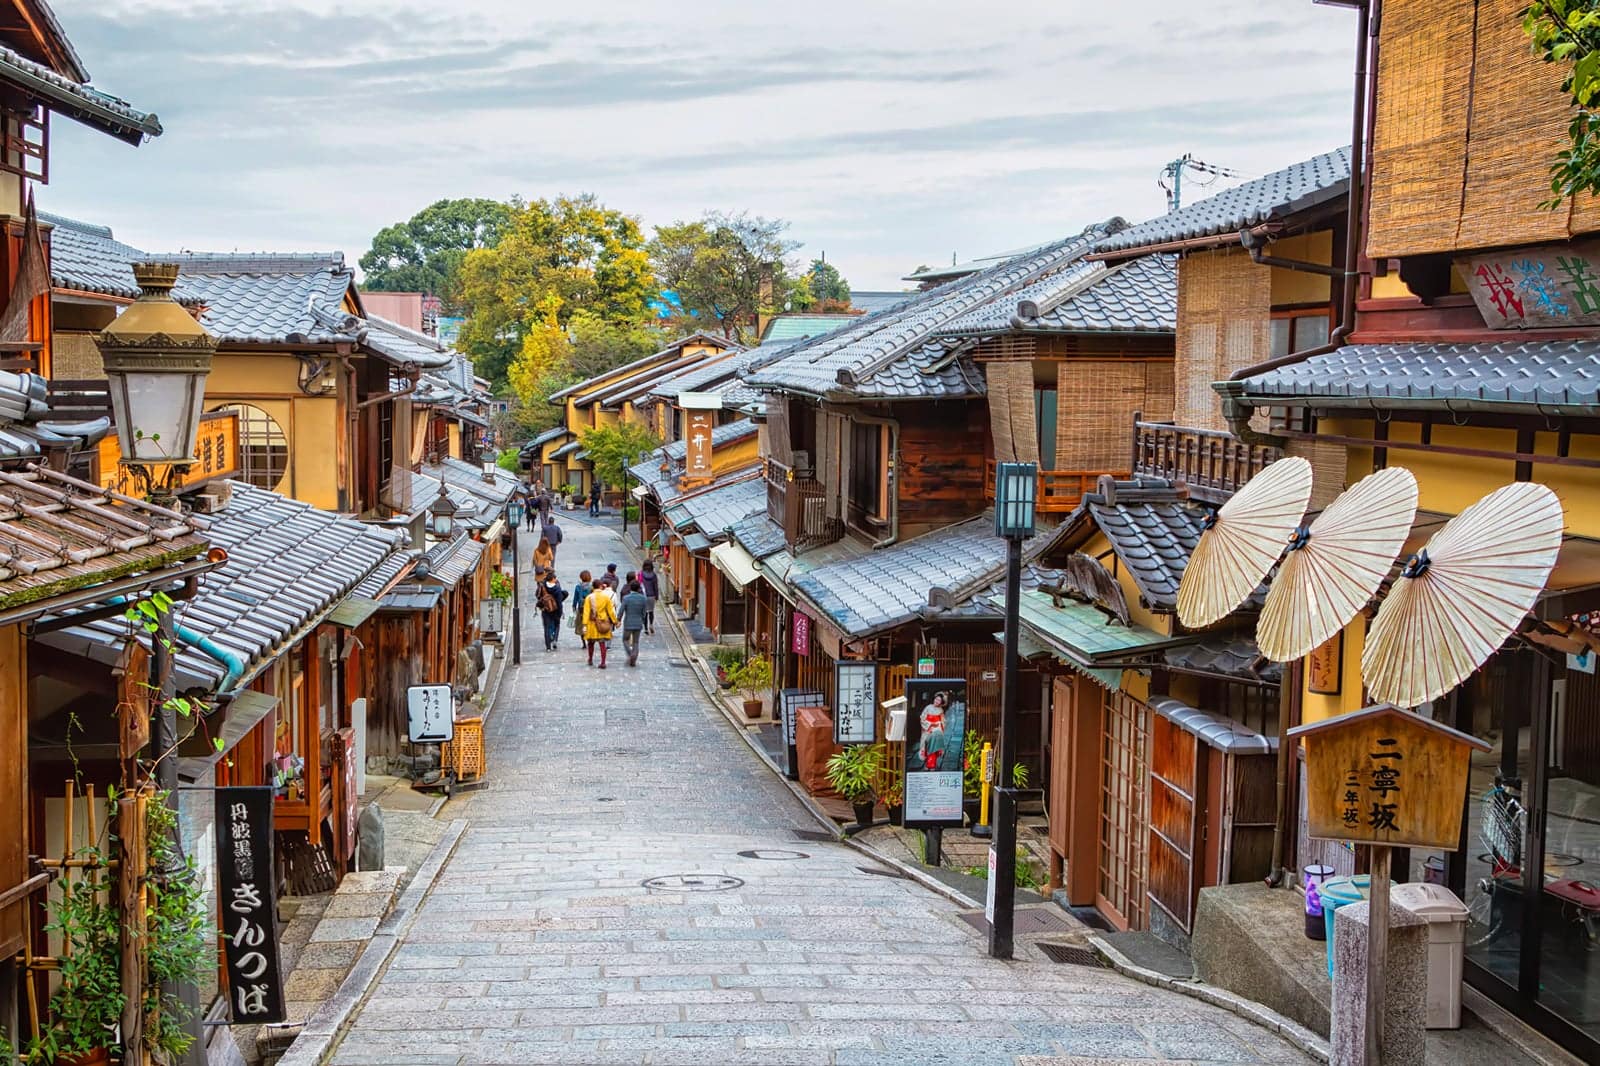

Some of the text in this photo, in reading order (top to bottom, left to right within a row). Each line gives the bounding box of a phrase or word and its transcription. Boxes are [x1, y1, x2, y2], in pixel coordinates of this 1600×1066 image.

[840, 704, 853, 735] ふたば
[1367, 738, 1403, 832] 二寧坂
[230, 882, 269, 1015] きんつば
